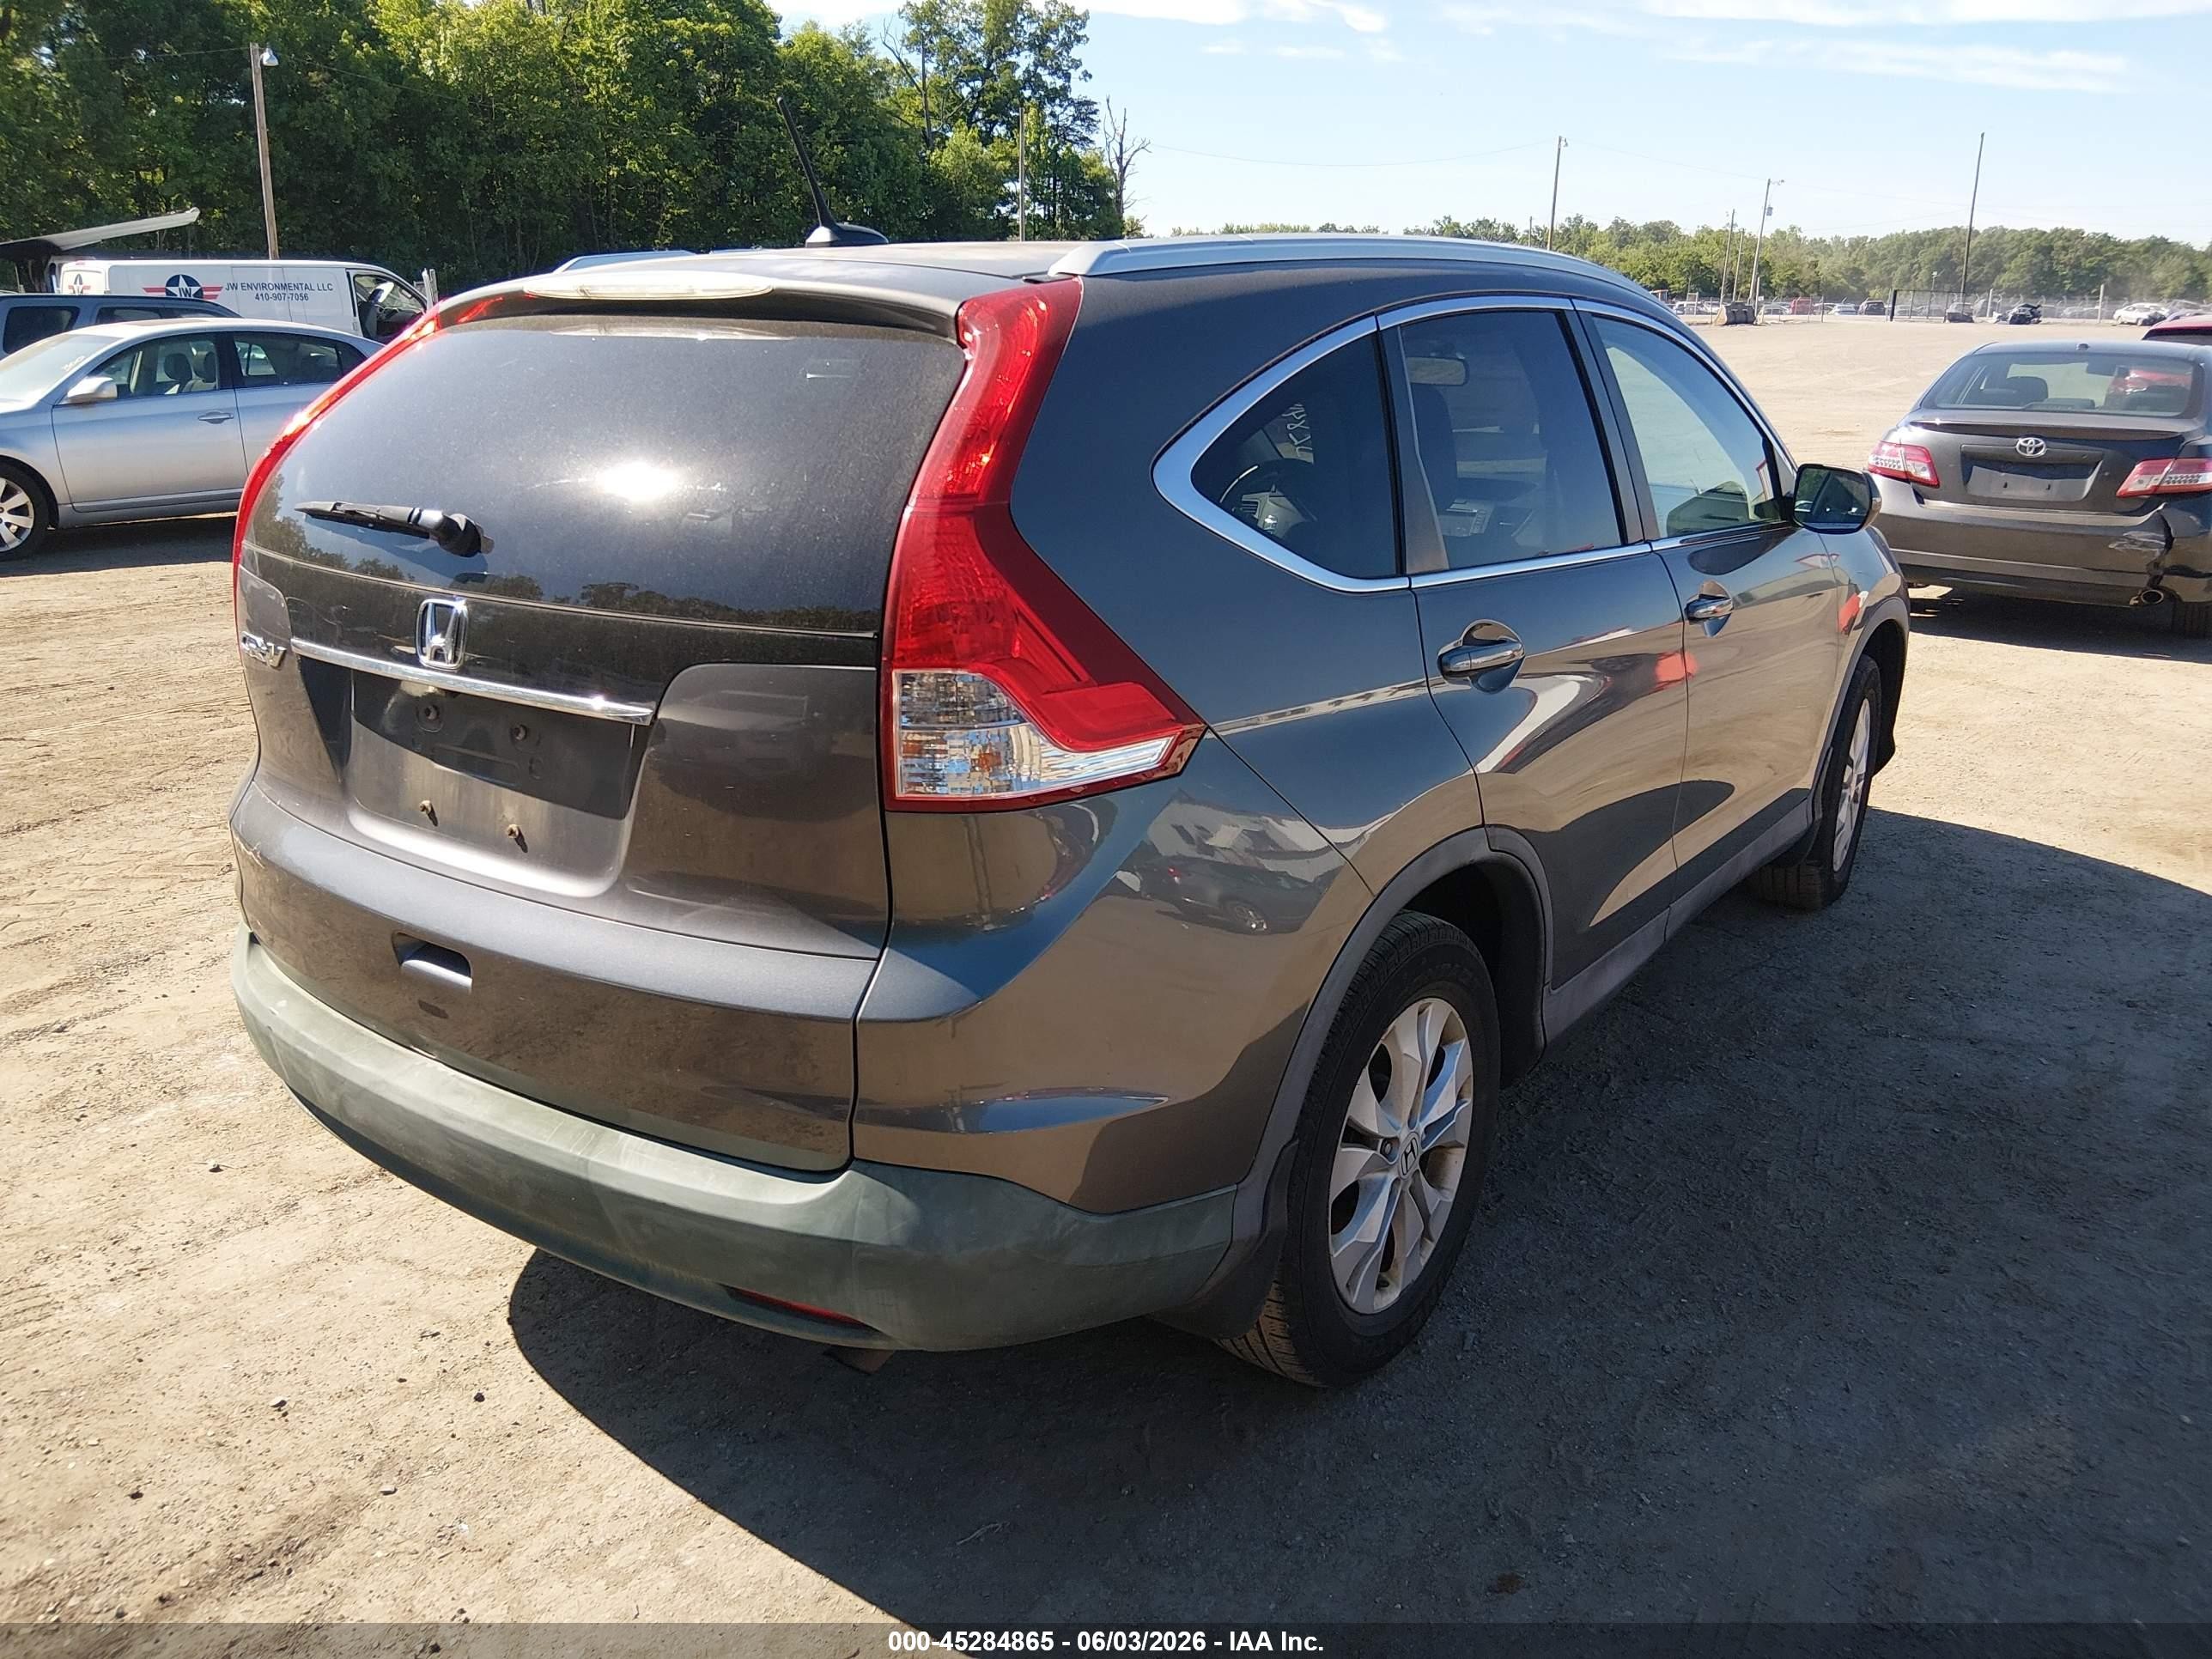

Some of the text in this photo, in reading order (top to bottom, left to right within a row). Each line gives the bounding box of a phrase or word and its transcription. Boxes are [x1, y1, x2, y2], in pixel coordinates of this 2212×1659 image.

[225, 283, 239, 291] JW
[240, 283, 315, 291] ENVIRONMENTAL
[254, 293, 310, 301] 410-907-7056
